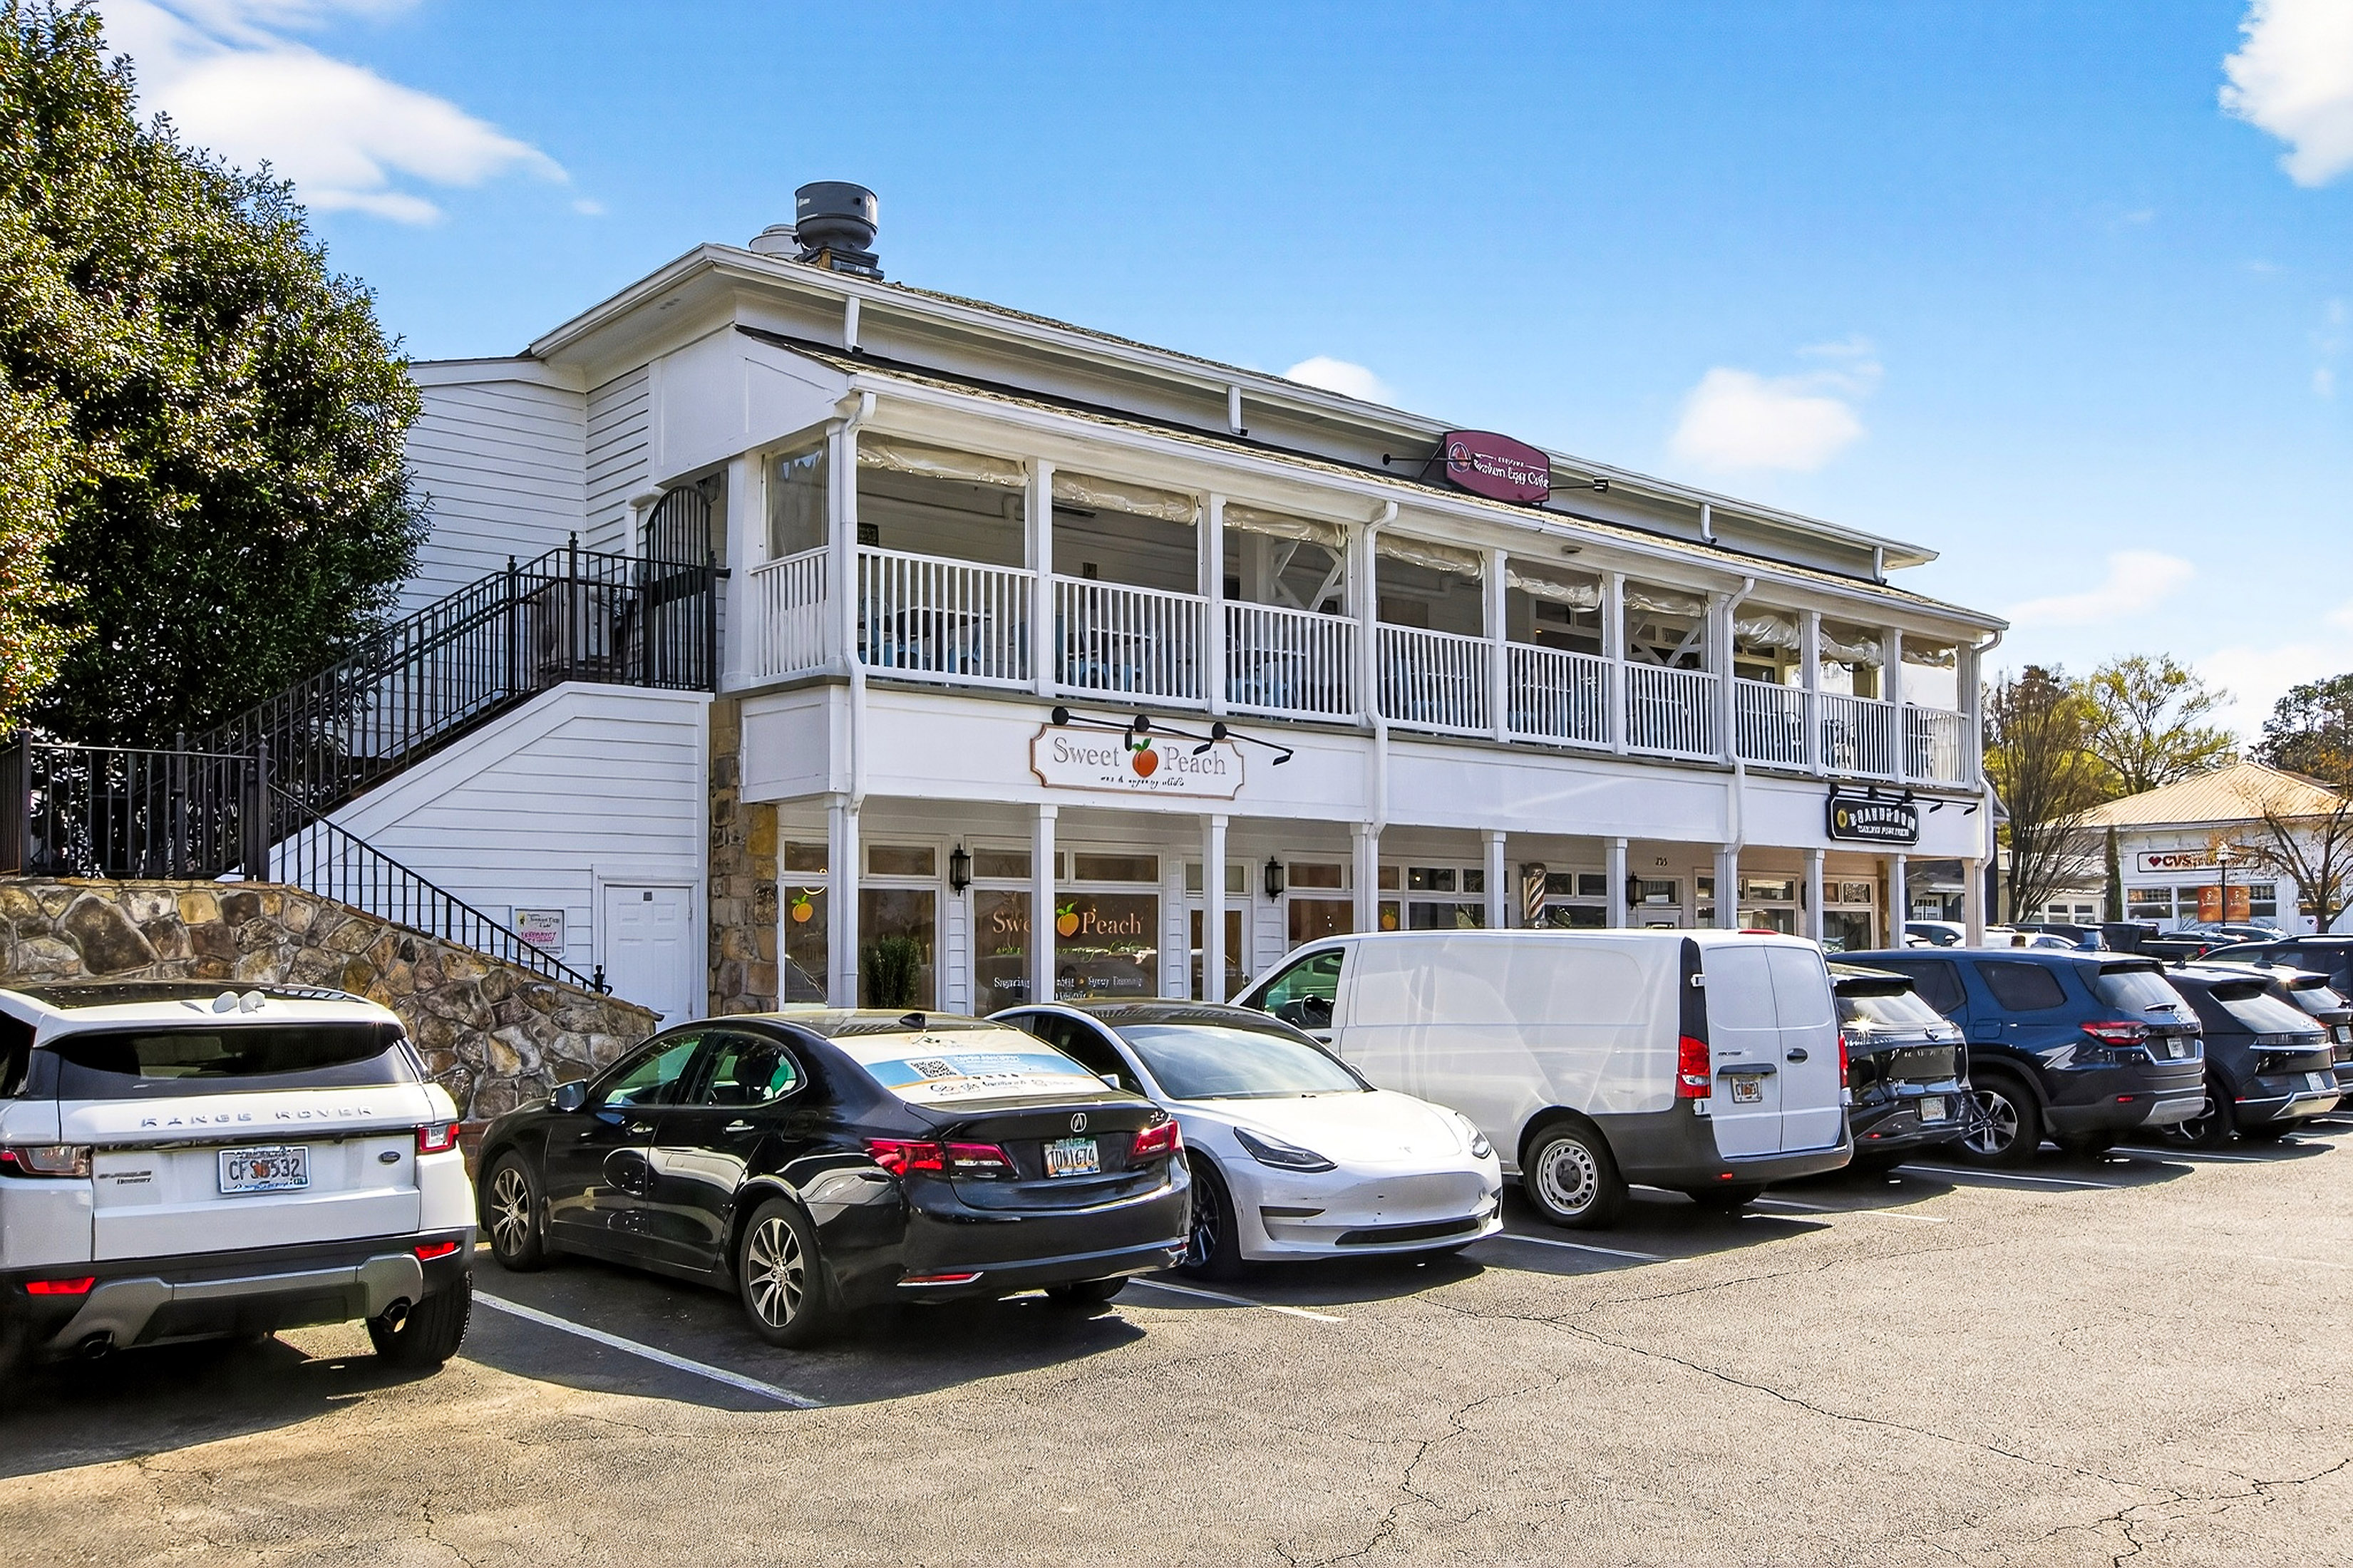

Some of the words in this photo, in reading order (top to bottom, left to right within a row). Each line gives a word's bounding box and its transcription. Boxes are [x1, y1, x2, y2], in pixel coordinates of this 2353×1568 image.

[1053, 736, 1120, 768] Sweet
[1163, 746, 1227, 776] Peach
[2162, 855, 2192, 868] CVS
[993, 909, 1031, 934] Swe
[1081, 911, 1143, 935] Peach
[141, 1113, 252, 1128] RANGE
[276, 1106, 373, 1120] ROVER
